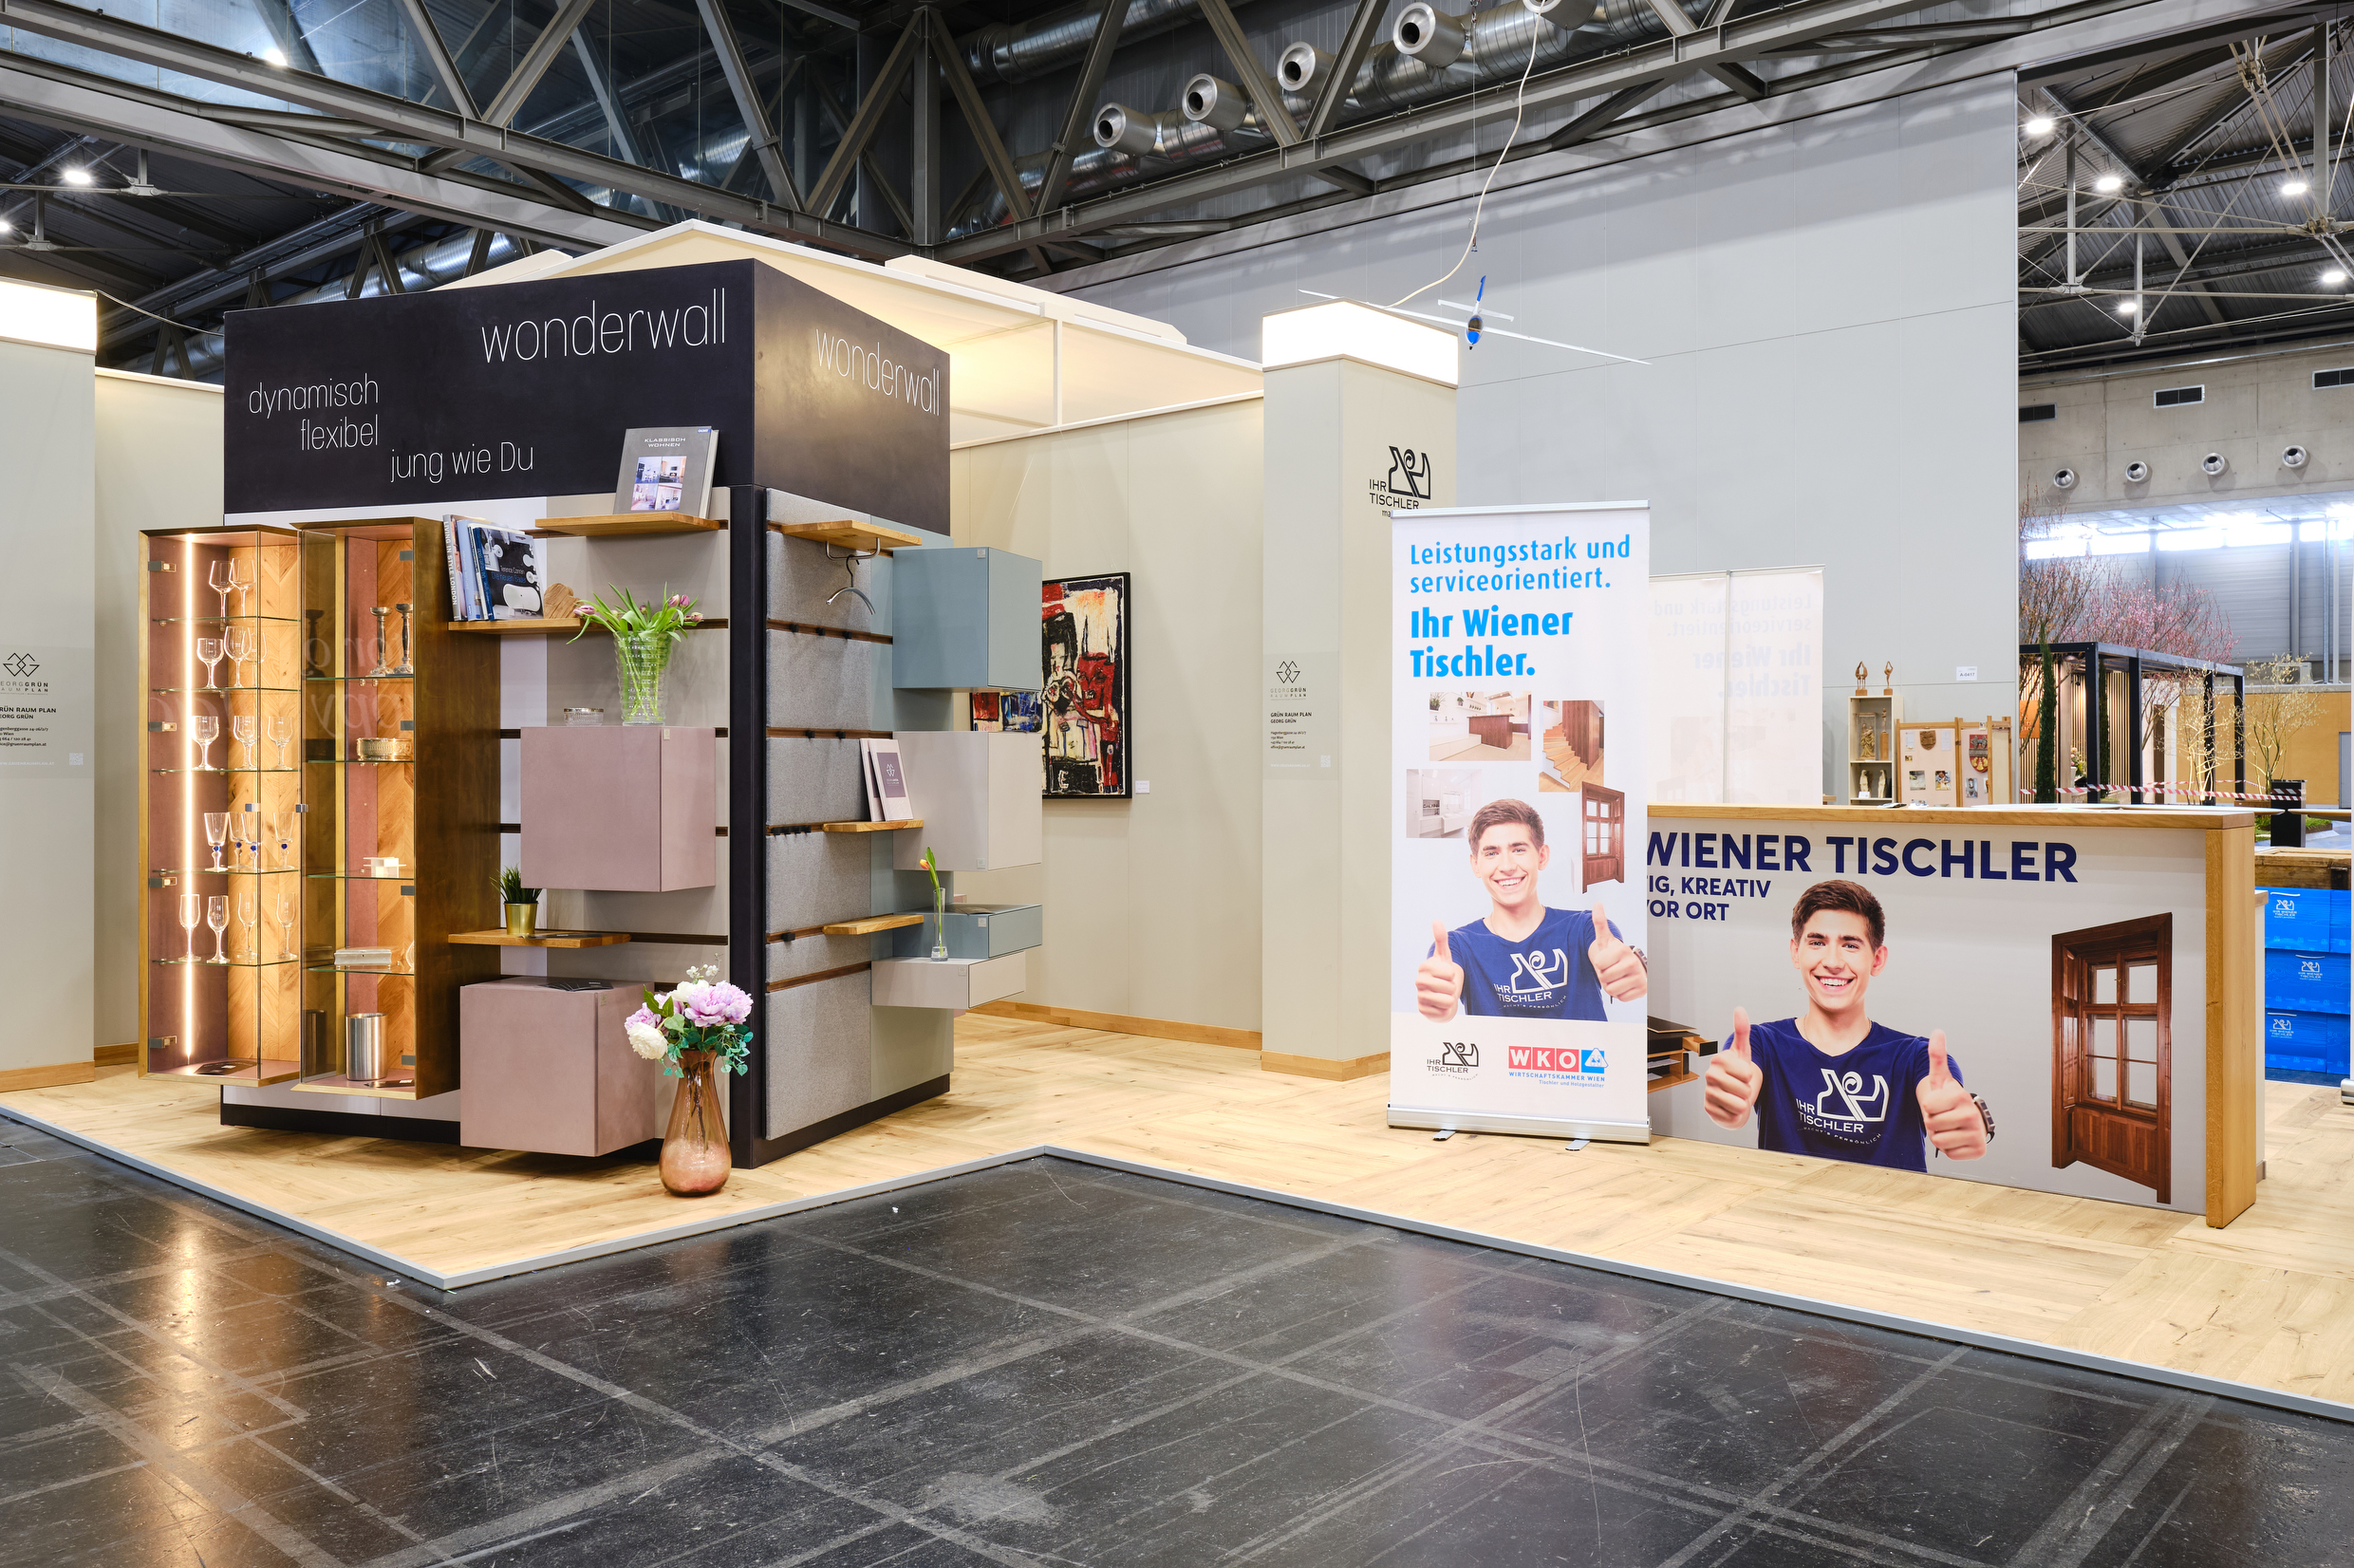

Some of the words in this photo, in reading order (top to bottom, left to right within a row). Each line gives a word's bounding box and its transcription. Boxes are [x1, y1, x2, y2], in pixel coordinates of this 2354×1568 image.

[481, 287, 726, 364] wonderwall
[815, 327, 942, 417] wonderwall
[249, 372, 379, 420] dynamisch
[300, 413, 379, 451] flexibel
[390, 448, 443, 484] jung
[452, 443, 492, 475] wie
[500, 441, 533, 472] Du
[1369, 478, 1387, 493] IHR
[1369, 492, 1420, 510] TISCHLER
[1411, 535, 1578, 569] Leistungsstark
[1586, 533, 1631, 559] und
[1410, 566, 1612, 594] serviceorientiert.
[1411, 607, 1454, 639] Ihr
[1462, 604, 1574, 638] Wiener
[1410, 644, 1536, 678] Tischler.
[1647, 831, 1812, 872] WIENER
[1825, 836, 2079, 883] TISCHLER
[1647, 874, 1675, 897] IG,
[1681, 876, 1772, 899] KREATIV
[1647, 899, 1680, 919] OR
[1685, 901, 1730, 922] ORT
[1494, 983, 1511, 995] IHR
[1497, 991, 1553, 1003] TISCHLER
[1427, 1065, 1469, 1073] TISCHLER
[1510, 1049, 1577, 1069] WKO
[1508, 1071, 1585, 1081] WIRTSCHAFTSKAMMER
[1796, 1098, 1816, 1115] IHR
[1798, 1111, 1864, 1133] TISCHLER
